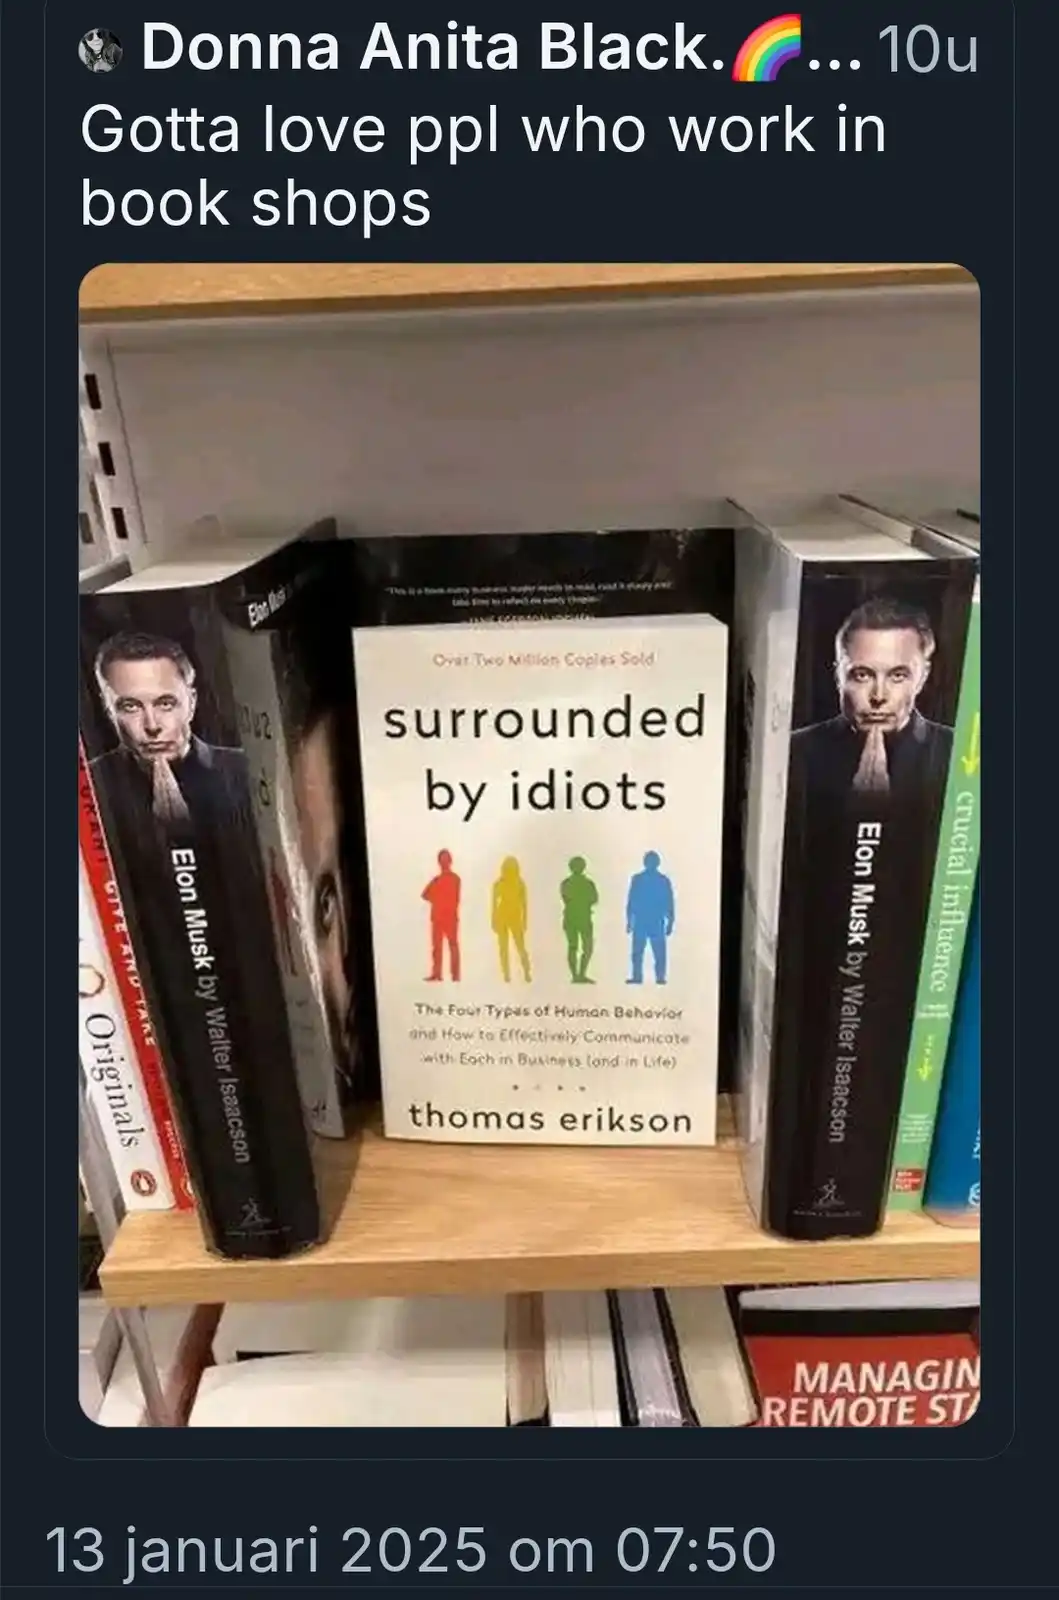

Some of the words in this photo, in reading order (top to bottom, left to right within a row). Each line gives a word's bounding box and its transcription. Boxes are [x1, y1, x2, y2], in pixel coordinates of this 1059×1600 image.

[432, 653, 469, 667] Over
[475, 652, 504, 667] Two
[508, 652, 560, 667] Million
[564, 652, 616, 669] Copies
[621, 651, 655, 667] Sold
[384, 693, 705, 739] surrounded
[426, 768, 487, 822] by
[511, 768, 666, 811] idiots
[855, 822, 882, 877] Elon
[946, 791, 974, 875] crucial
[171, 848, 197, 902] Elon
[184, 908, 215, 970] Musk
[848, 884, 876, 946] Musk
[930, 884, 970, 993] influence
[195, 975, 219, 1001] by
[839, 952, 868, 979] by
[408, 1028, 437, 1041] and
[441, 1027, 474, 1041] How
[479, 1029, 495, 1042] to
[499, 1027, 577, 1044] Effectively
[582, 1029, 690, 1044] Communicate
[414, 1002, 443, 1016] The
[448, 1003, 481, 1017] Four
[485, 1003, 530, 1019] Types
[534, 1004, 550, 1018] of
[554, 1005, 609, 1018] Human
[614, 1005, 683, 1020] Behavior
[838, 984, 866, 1052] Walter
[205, 1007, 232, 1073] Walter
[420, 1051, 454, 1065] with
[459, 1051, 495, 1066] Each
[500, 1054, 514, 1066] in
[517, 1052, 582, 1068] Business
[586, 1053, 620, 1069] (and
[625, 1055, 639, 1068] in
[643, 1054, 678, 1070] Life)
[84, 1013, 145, 1148] Originals
[829, 1056, 857, 1144] Isaacson
[217, 1077, 250, 1164] Isaacson
[408, 1102, 545, 1131] thomas
[560, 1106, 692, 1133] erikson
[762, 1395, 917, 1427] REMOTE
